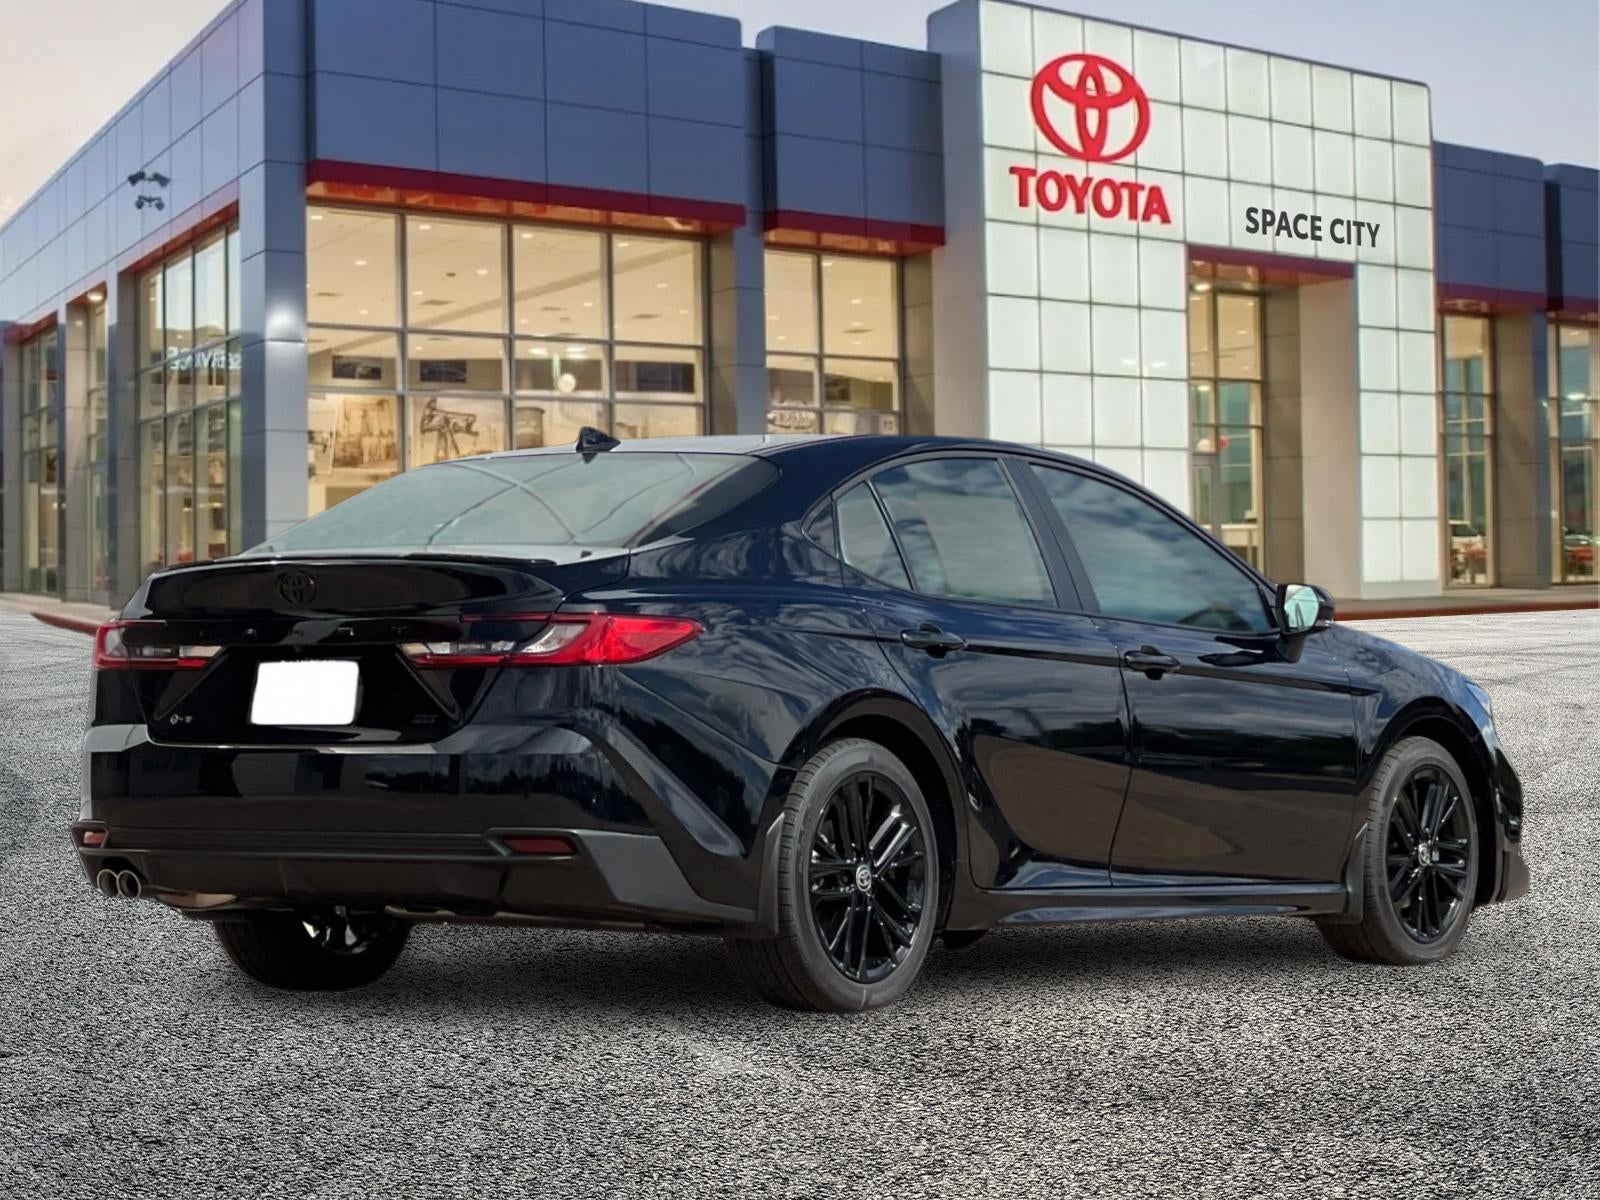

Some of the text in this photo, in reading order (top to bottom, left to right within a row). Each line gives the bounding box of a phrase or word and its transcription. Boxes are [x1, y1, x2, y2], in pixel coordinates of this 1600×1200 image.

[1009, 166, 1171, 224] TOYOTA
[1245, 206, 1381, 248] SPACE CITY
